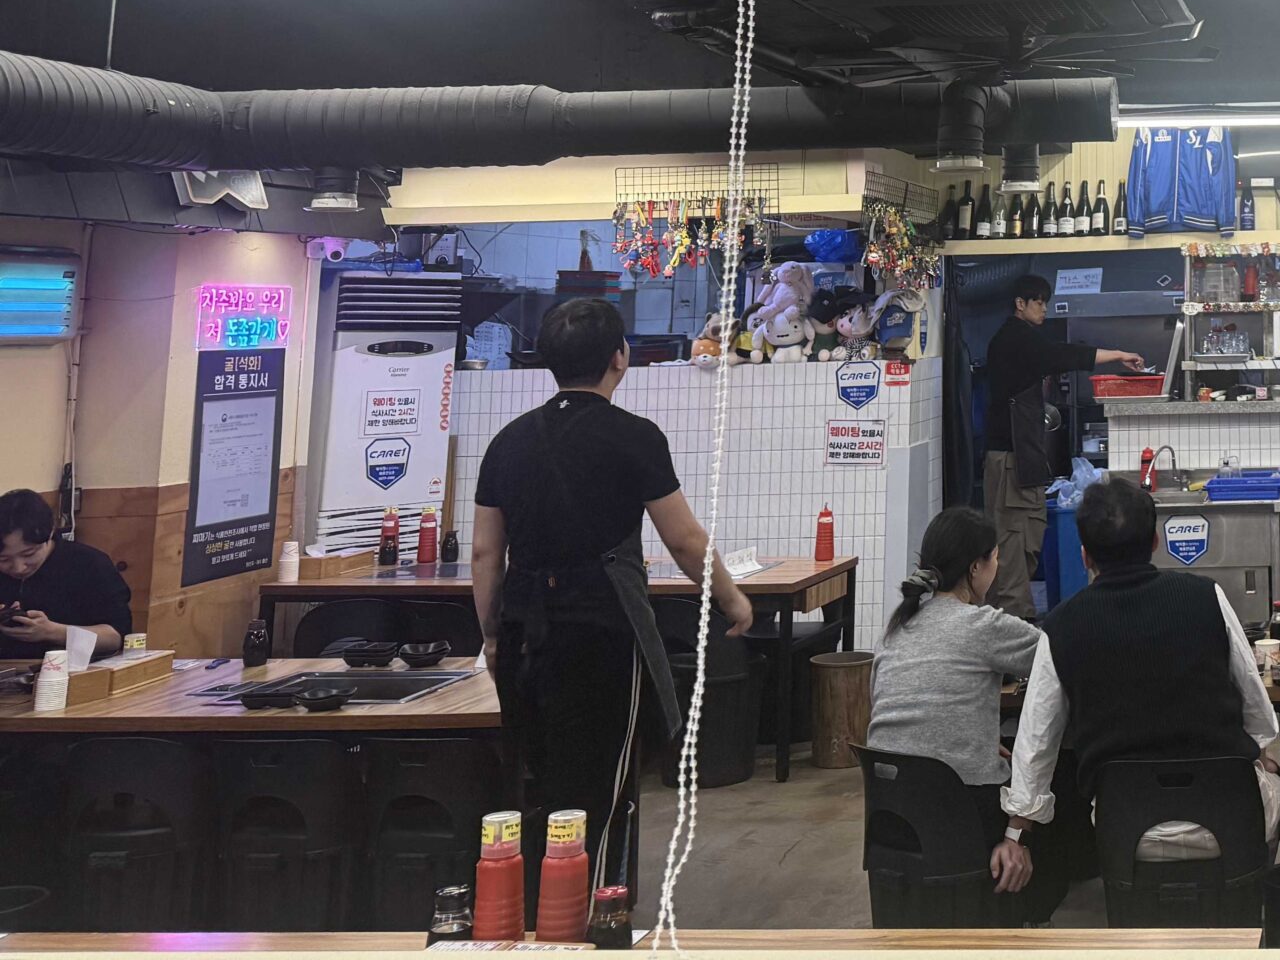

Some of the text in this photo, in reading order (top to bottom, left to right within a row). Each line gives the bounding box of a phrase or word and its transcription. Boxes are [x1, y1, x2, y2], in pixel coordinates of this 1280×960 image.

[1186, 129, 1203, 148] SL
[202, 289, 284, 314] 자주봐요 우리
[206, 319, 221, 343] 저
[840, 371, 876, 381] CARE1
[214, 373, 268, 390] 합격 통지서
[372, 397, 396, 407] 웨이팅
[371, 408, 415, 417] 식사시간 2시간
[830, 426, 883, 437] 웨이팅 있을시
[829, 442, 882, 450] 식사시간 2시간
[369, 447, 407, 459] CARE1
[828, 451, 881, 460] 제한 양해바랍니다
[1168, 524, 1206, 534] CARE1
